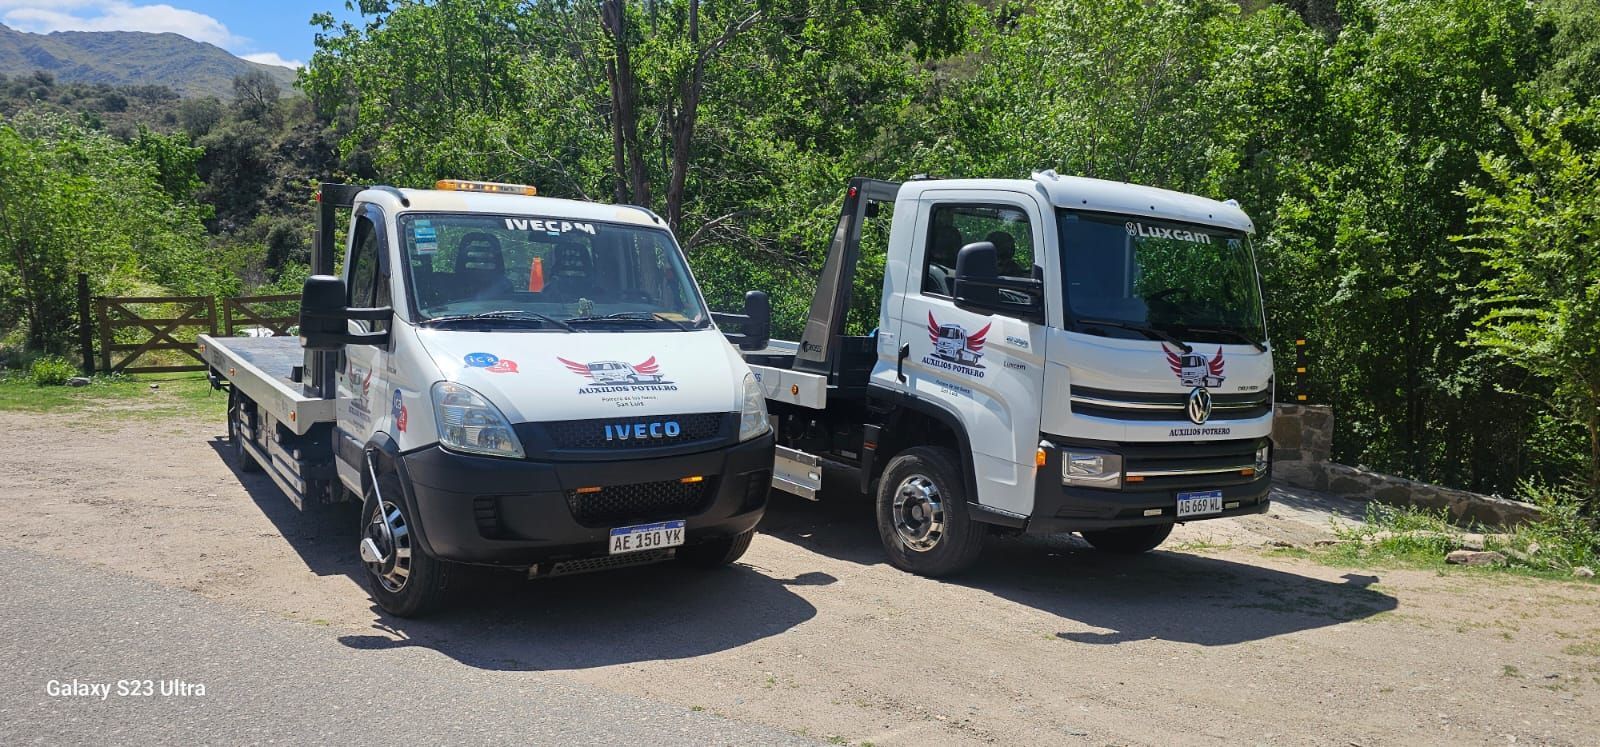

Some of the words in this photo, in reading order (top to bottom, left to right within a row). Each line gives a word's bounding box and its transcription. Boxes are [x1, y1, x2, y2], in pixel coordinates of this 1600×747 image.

[505, 218, 596, 235] IVECAM
[1137, 222, 1211, 244] Luxcam
[922, 356, 952, 370] AUXILIOS
[953, 363, 985, 378] POTRERO
[578, 386, 629, 395] AUXILIOS
[604, 421, 681, 441] IVECO
[1168, 428, 1200, 436] AUXILIOS
[1201, 427, 1231, 435] POTRERO
[1179, 500, 1190, 515] AG
[1192, 499, 1208, 513] 669
[614, 535, 631, 552] AE
[635, 531, 661, 548] 150
[665, 528, 682, 545] YK
